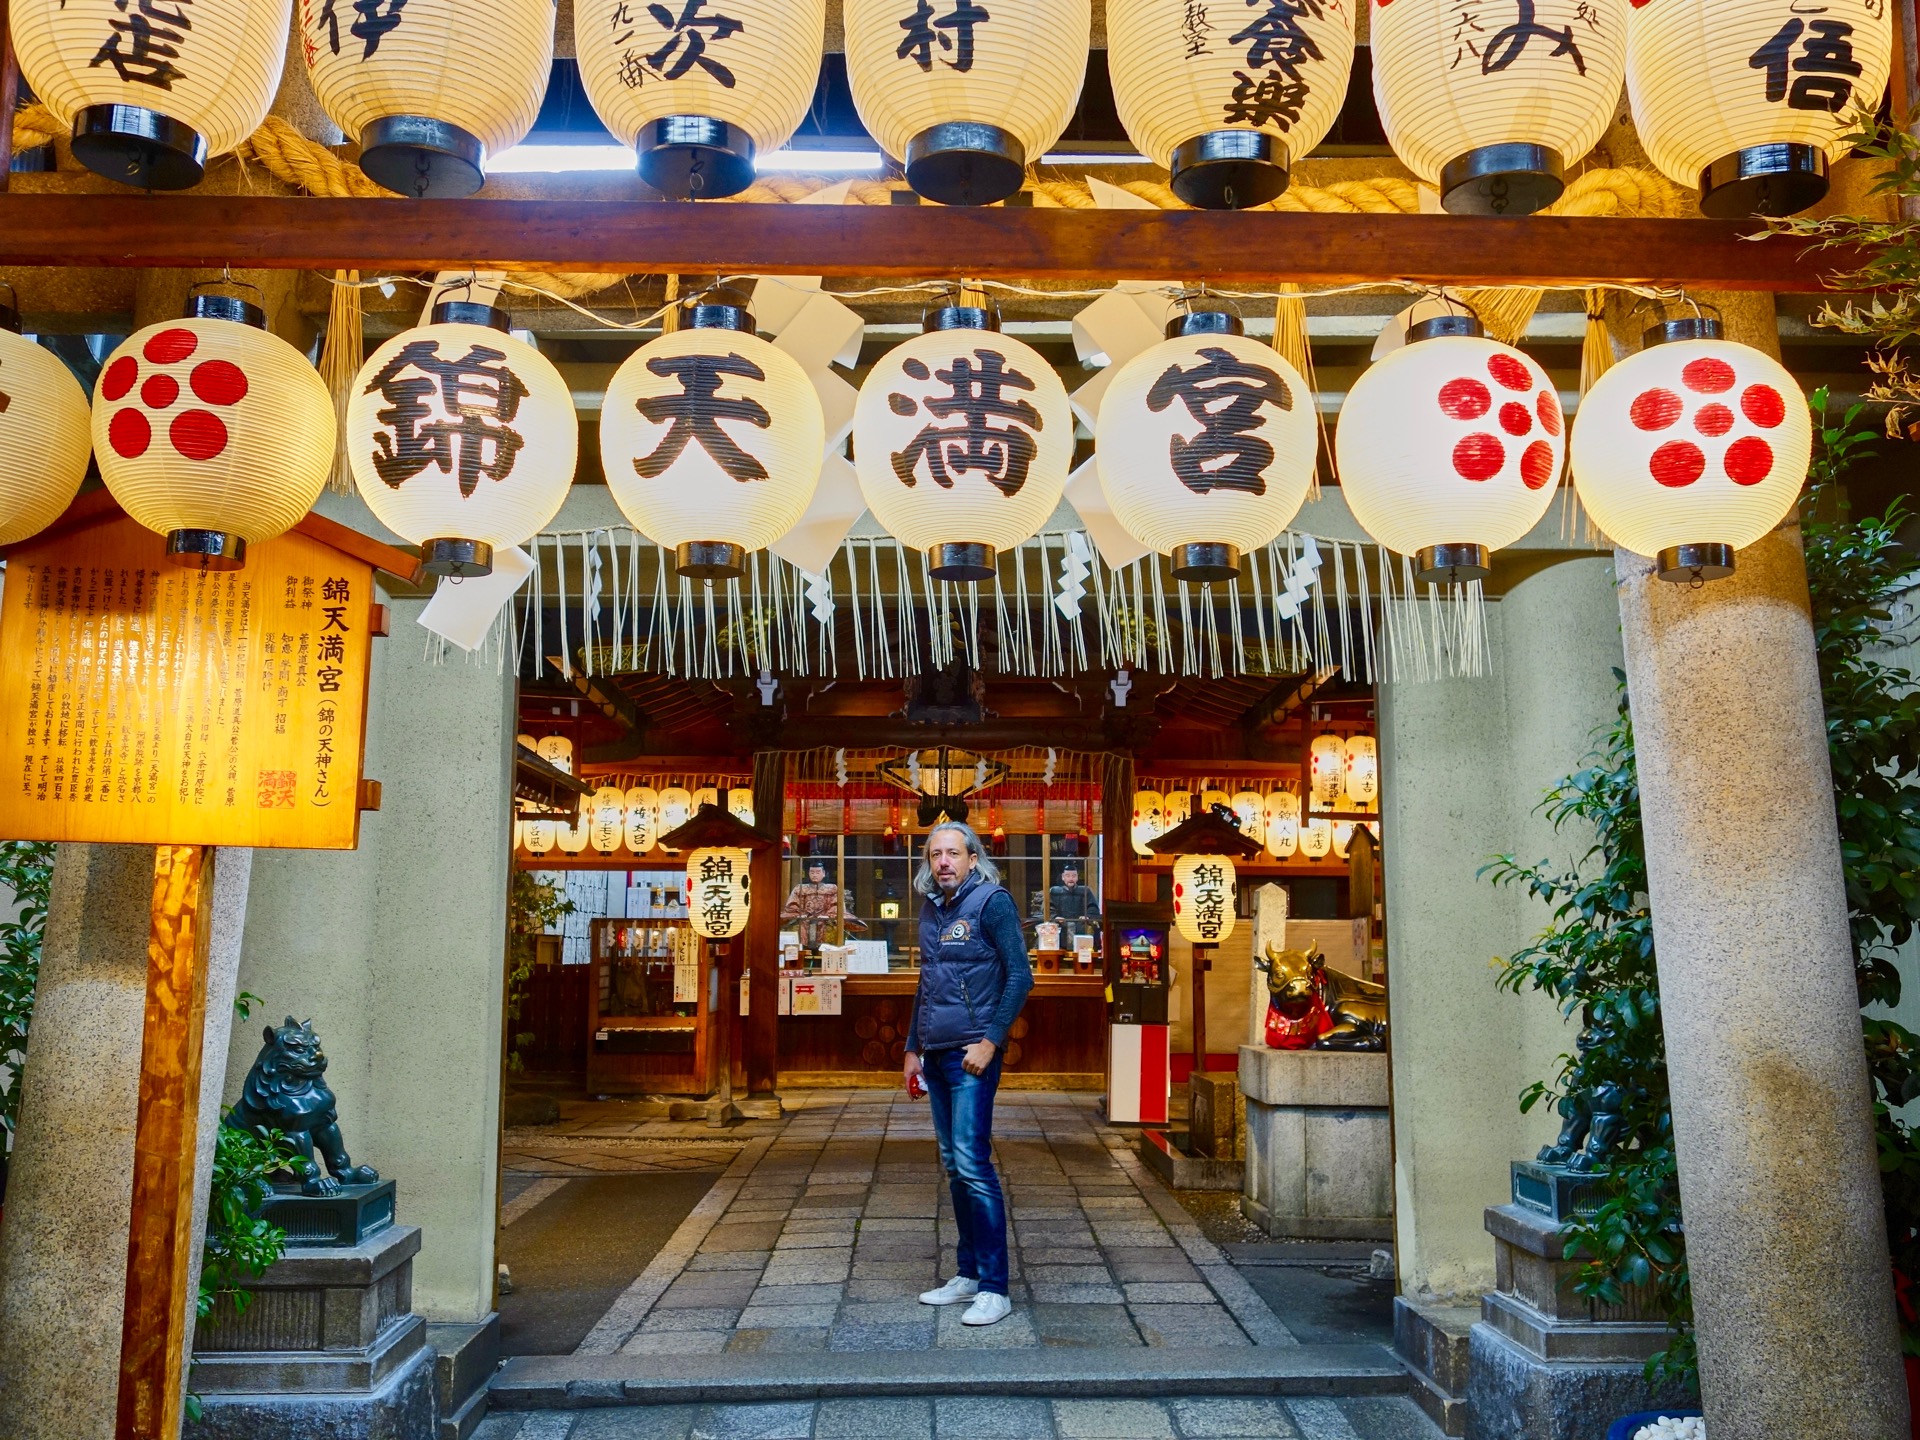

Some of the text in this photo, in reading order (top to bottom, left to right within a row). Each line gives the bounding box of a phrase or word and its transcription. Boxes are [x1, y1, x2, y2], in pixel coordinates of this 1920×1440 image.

[896, 0, 989, 73] 村
[1181, 0, 1217, 60] 教室
[364, 341, 1293, 498] 錦 天 満 宮
[284, 575, 298, 609] 御利益
[296, 575, 315, 687] 御祭神 菅原道真公
[700, 856, 733, 936] 錦天満宮
[1193, 863, 1224, 939] 錦天満宮
